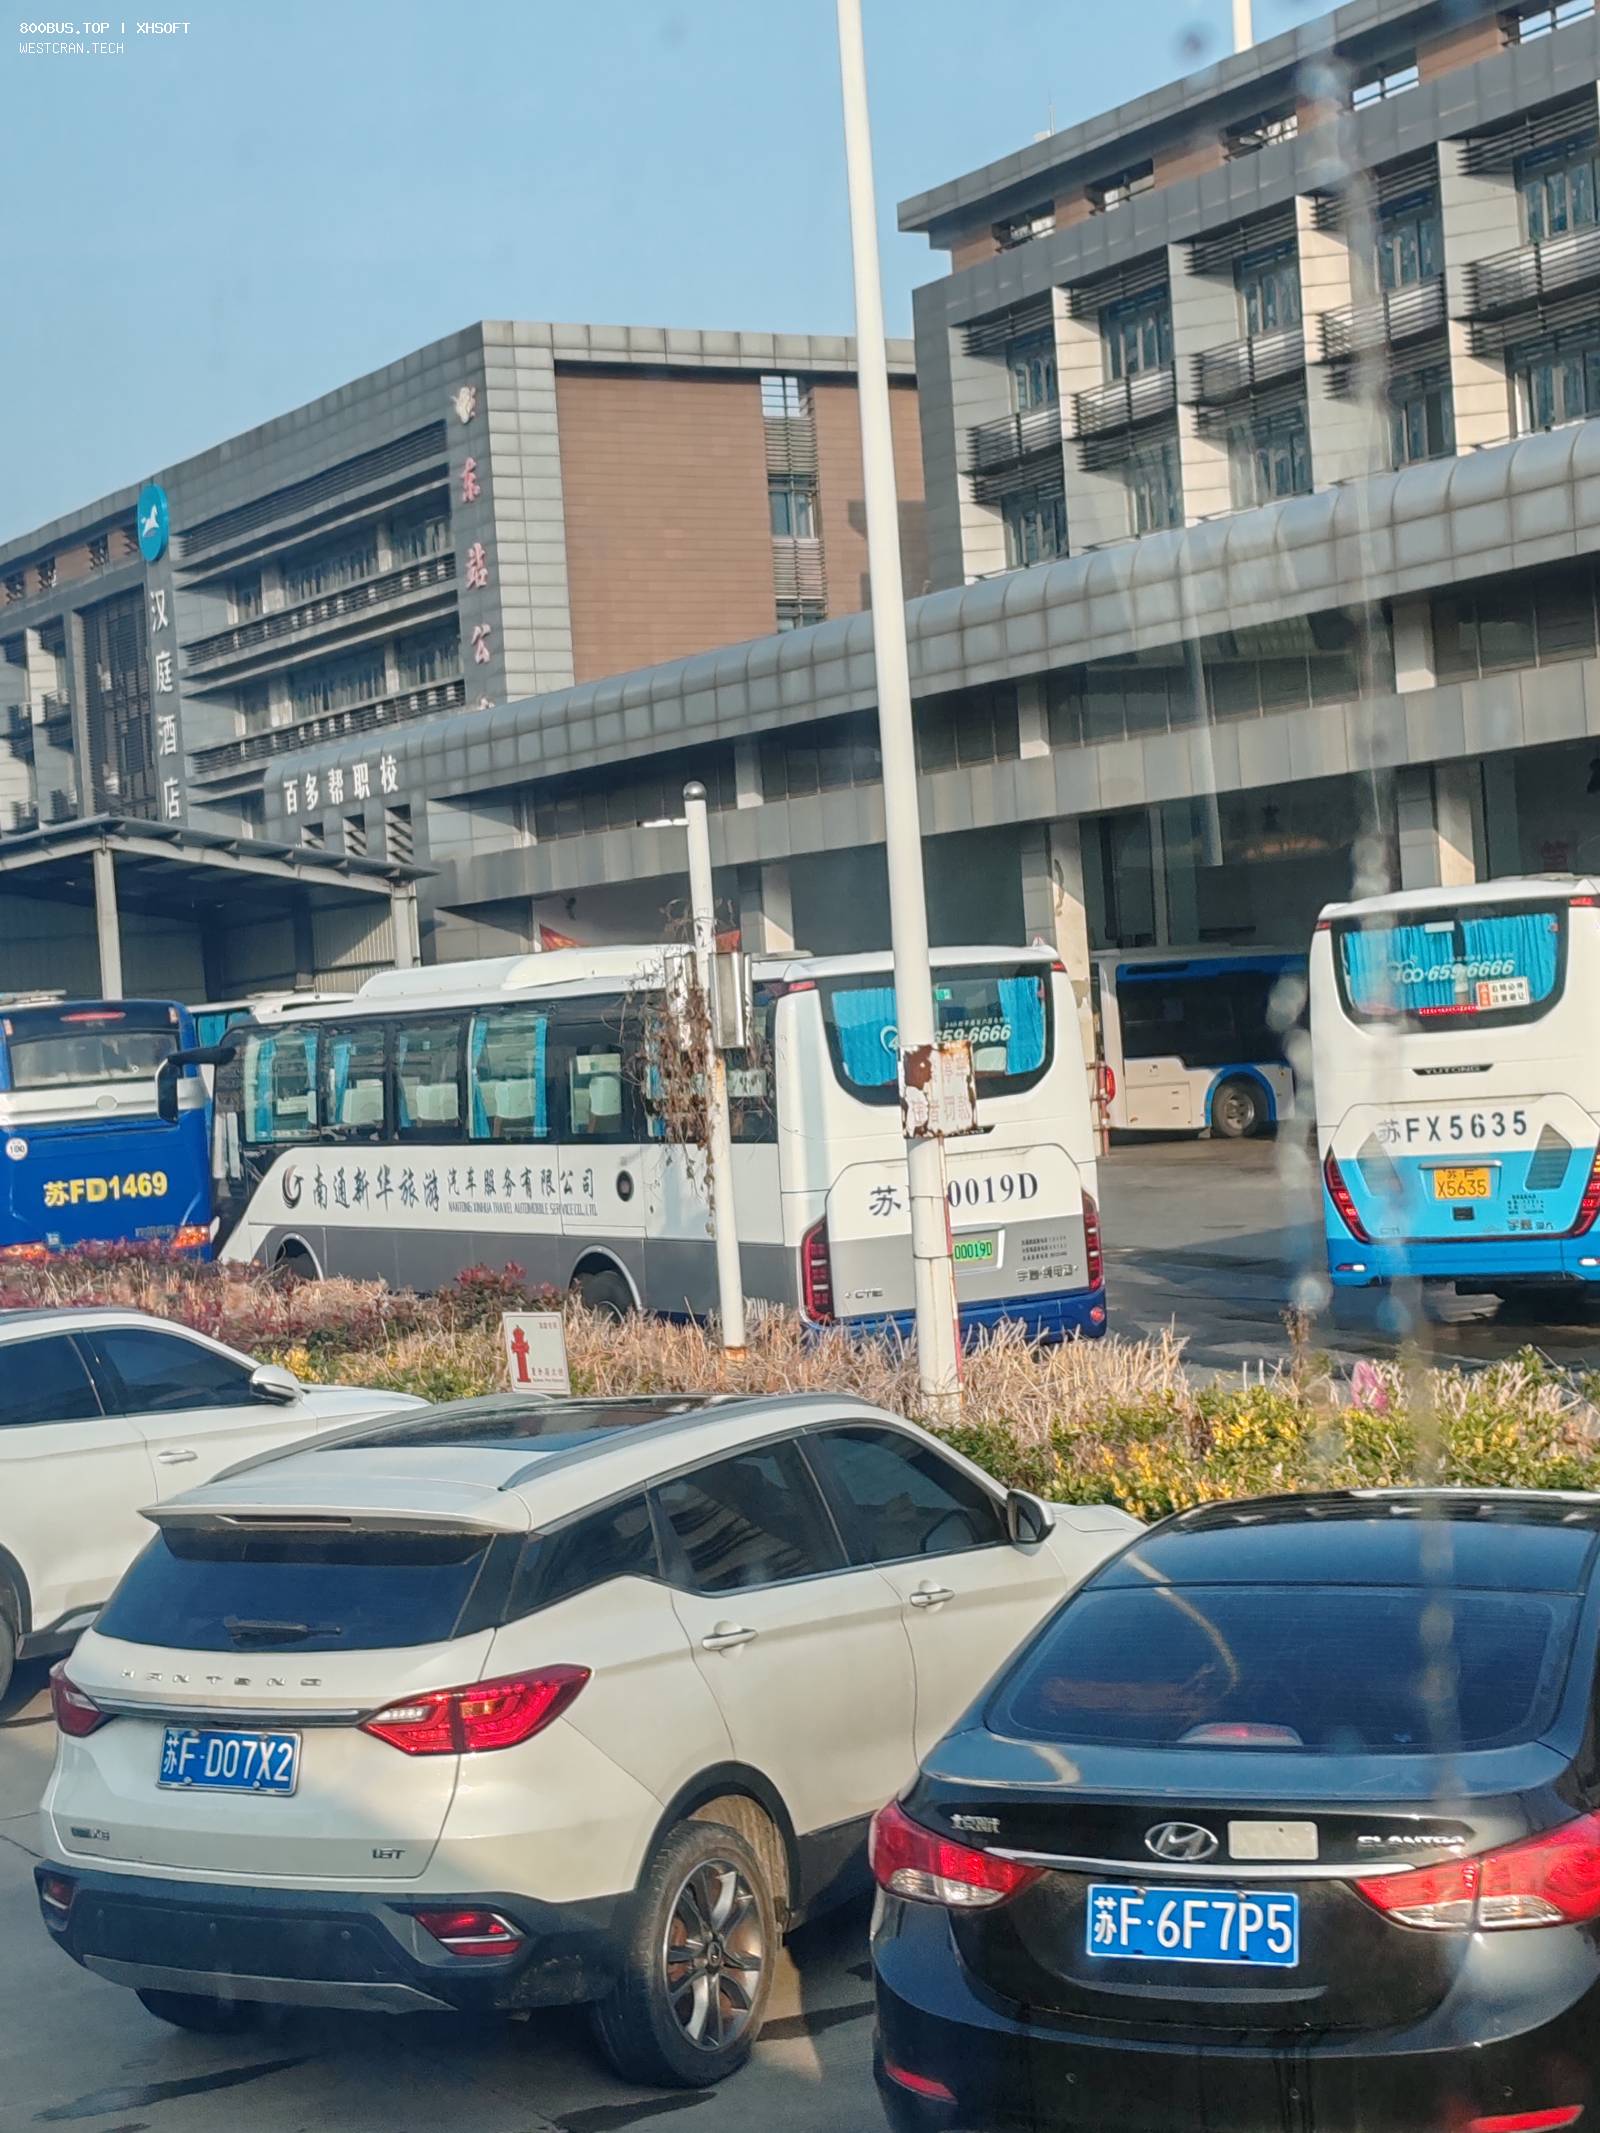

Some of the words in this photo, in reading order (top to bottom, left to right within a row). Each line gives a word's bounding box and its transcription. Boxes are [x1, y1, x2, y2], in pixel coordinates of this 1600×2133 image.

[150, 589, 182, 820] 汉庭酒店
[283, 755, 399, 815] 百多帮职校
[1378, 1110, 1527, 1145] 苏FX5635
[44, 1171, 168, 1208] 苏FD1469
[1437, 1179, 1487, 1197] X5635
